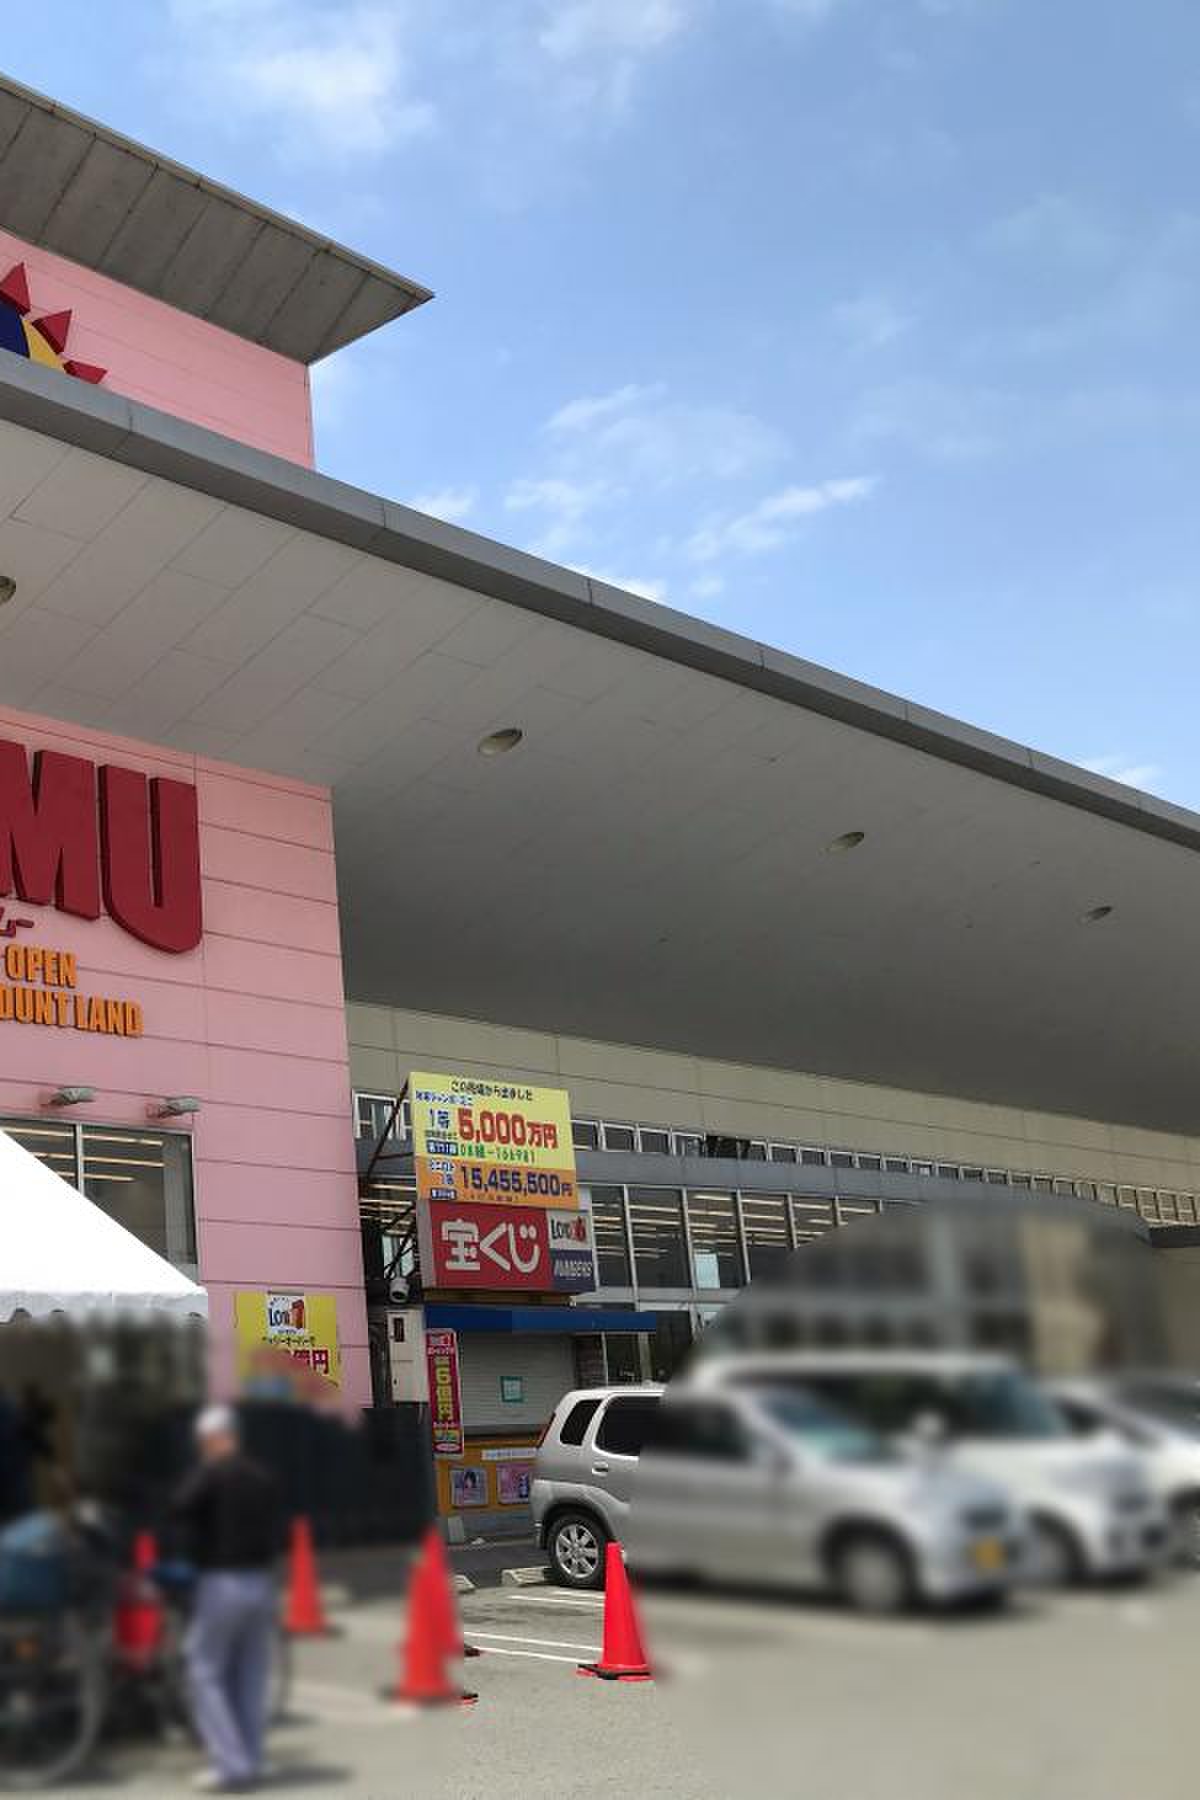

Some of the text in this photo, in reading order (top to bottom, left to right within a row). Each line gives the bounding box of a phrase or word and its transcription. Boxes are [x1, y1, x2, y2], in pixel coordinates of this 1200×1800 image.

[5, 944, 78, 989] OPEN
[73, 992, 145, 1038] LAND
[457, 1107, 559, 1150] 5,000万円
[461, 1166, 573, 1198] 15,455,500円
[441, 1218, 541, 1274] 宝くじ
